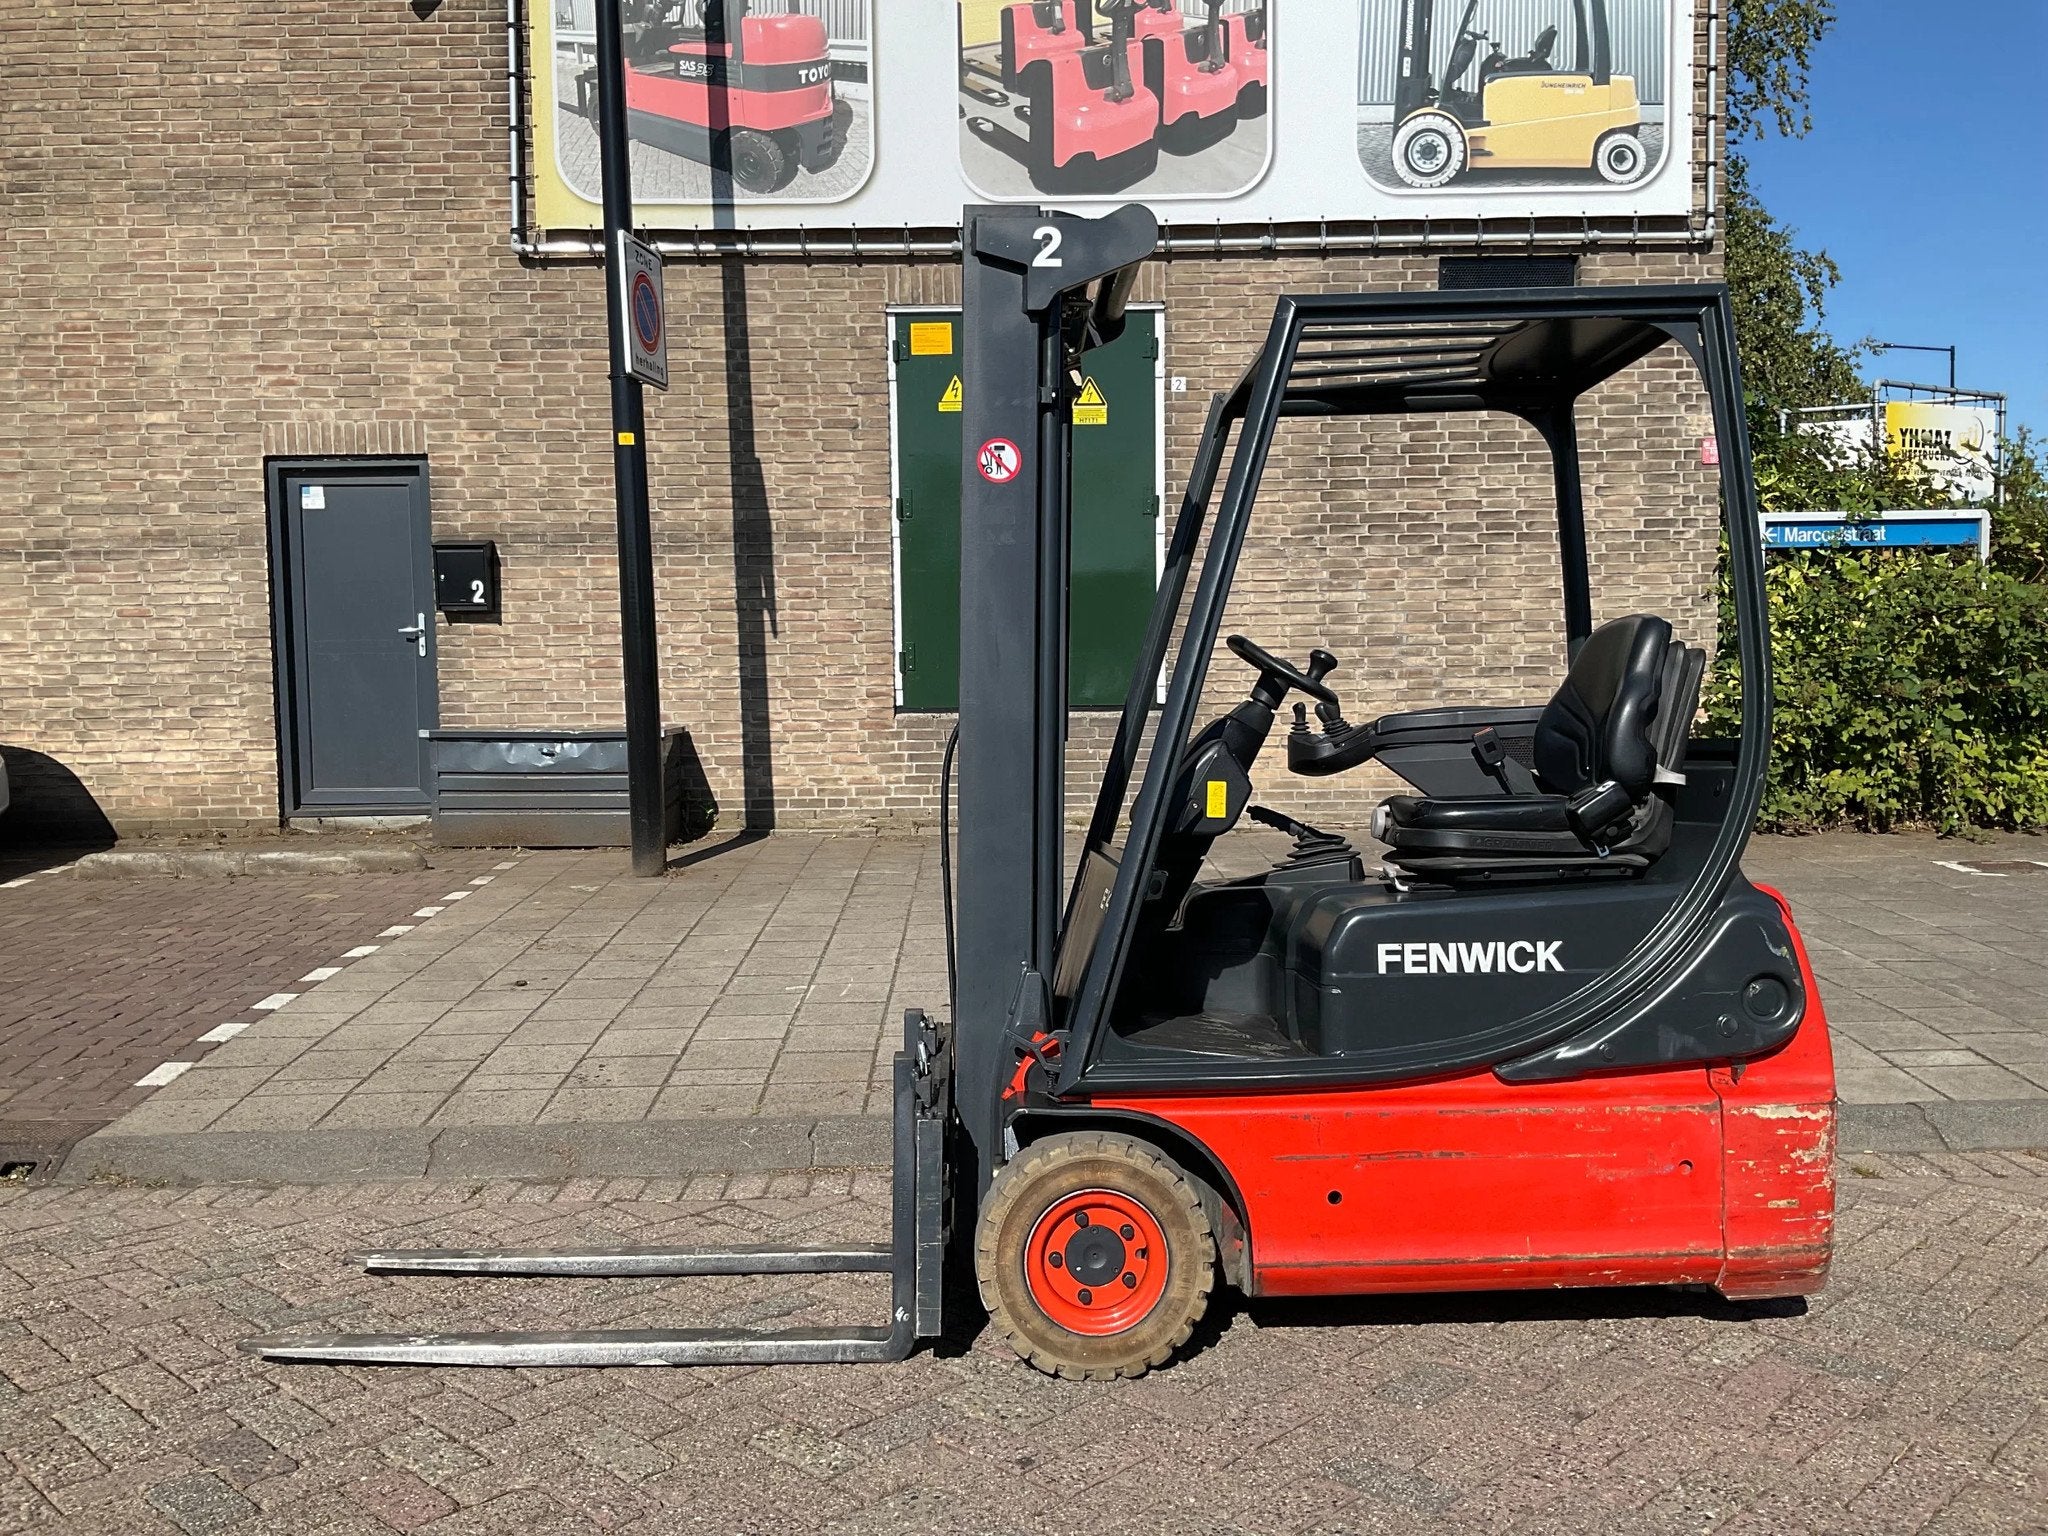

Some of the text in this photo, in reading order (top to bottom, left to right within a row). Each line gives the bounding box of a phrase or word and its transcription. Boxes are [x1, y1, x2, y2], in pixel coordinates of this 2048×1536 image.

[679, 60, 696, 71] SAS
[1031, 226, 1063, 268] 2
[635, 249, 653, 271] ZONE
[635, 353, 664, 380] herhaling
[1175, 379, 1182, 391] 2
[471, 580, 485, 603] 2
[1377, 940, 1565, 974] FENWICK
